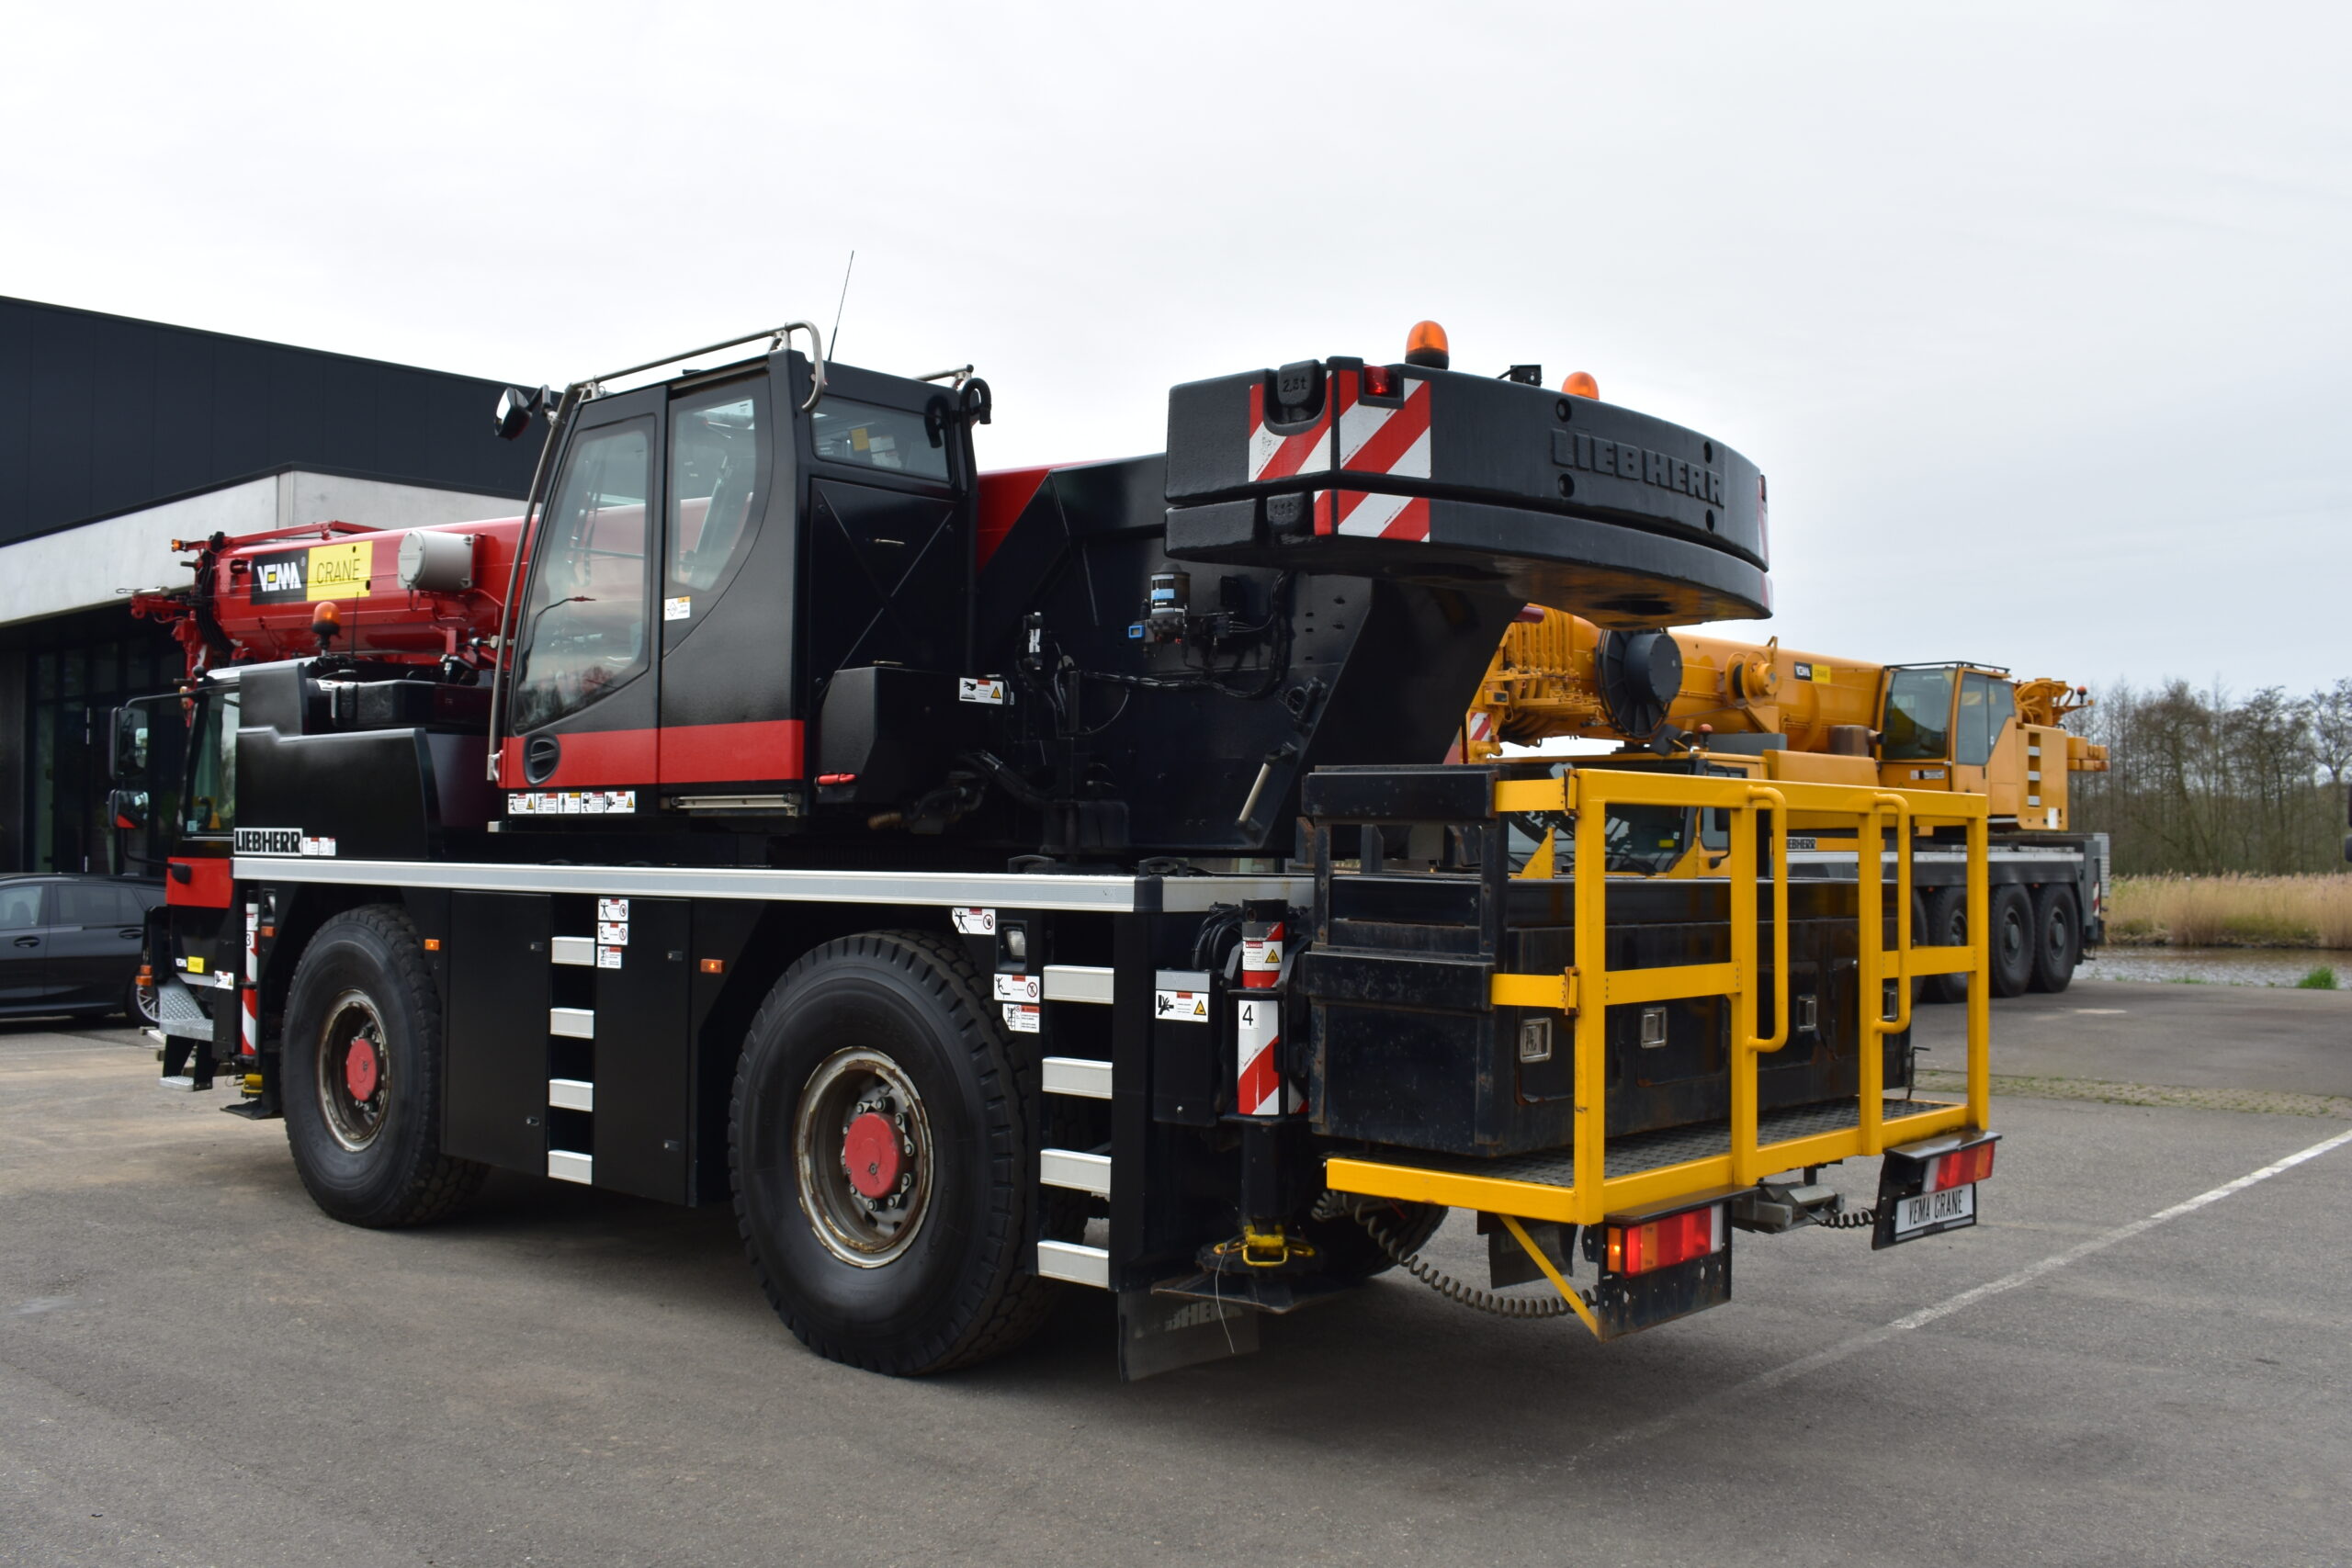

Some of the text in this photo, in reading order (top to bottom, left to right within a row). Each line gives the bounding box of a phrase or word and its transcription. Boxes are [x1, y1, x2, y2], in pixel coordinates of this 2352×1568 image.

[1552, 427, 1724, 509] LIEBHERR
[257, 558, 360, 592] VEMA CRANE
[235, 830, 301, 853] LIEBHERR
[1787, 838, 1815, 850] IEBHERR
[1242, 1004, 1254, 1026] 4
[1909, 1190, 1962, 1225] VEMA CRANE
